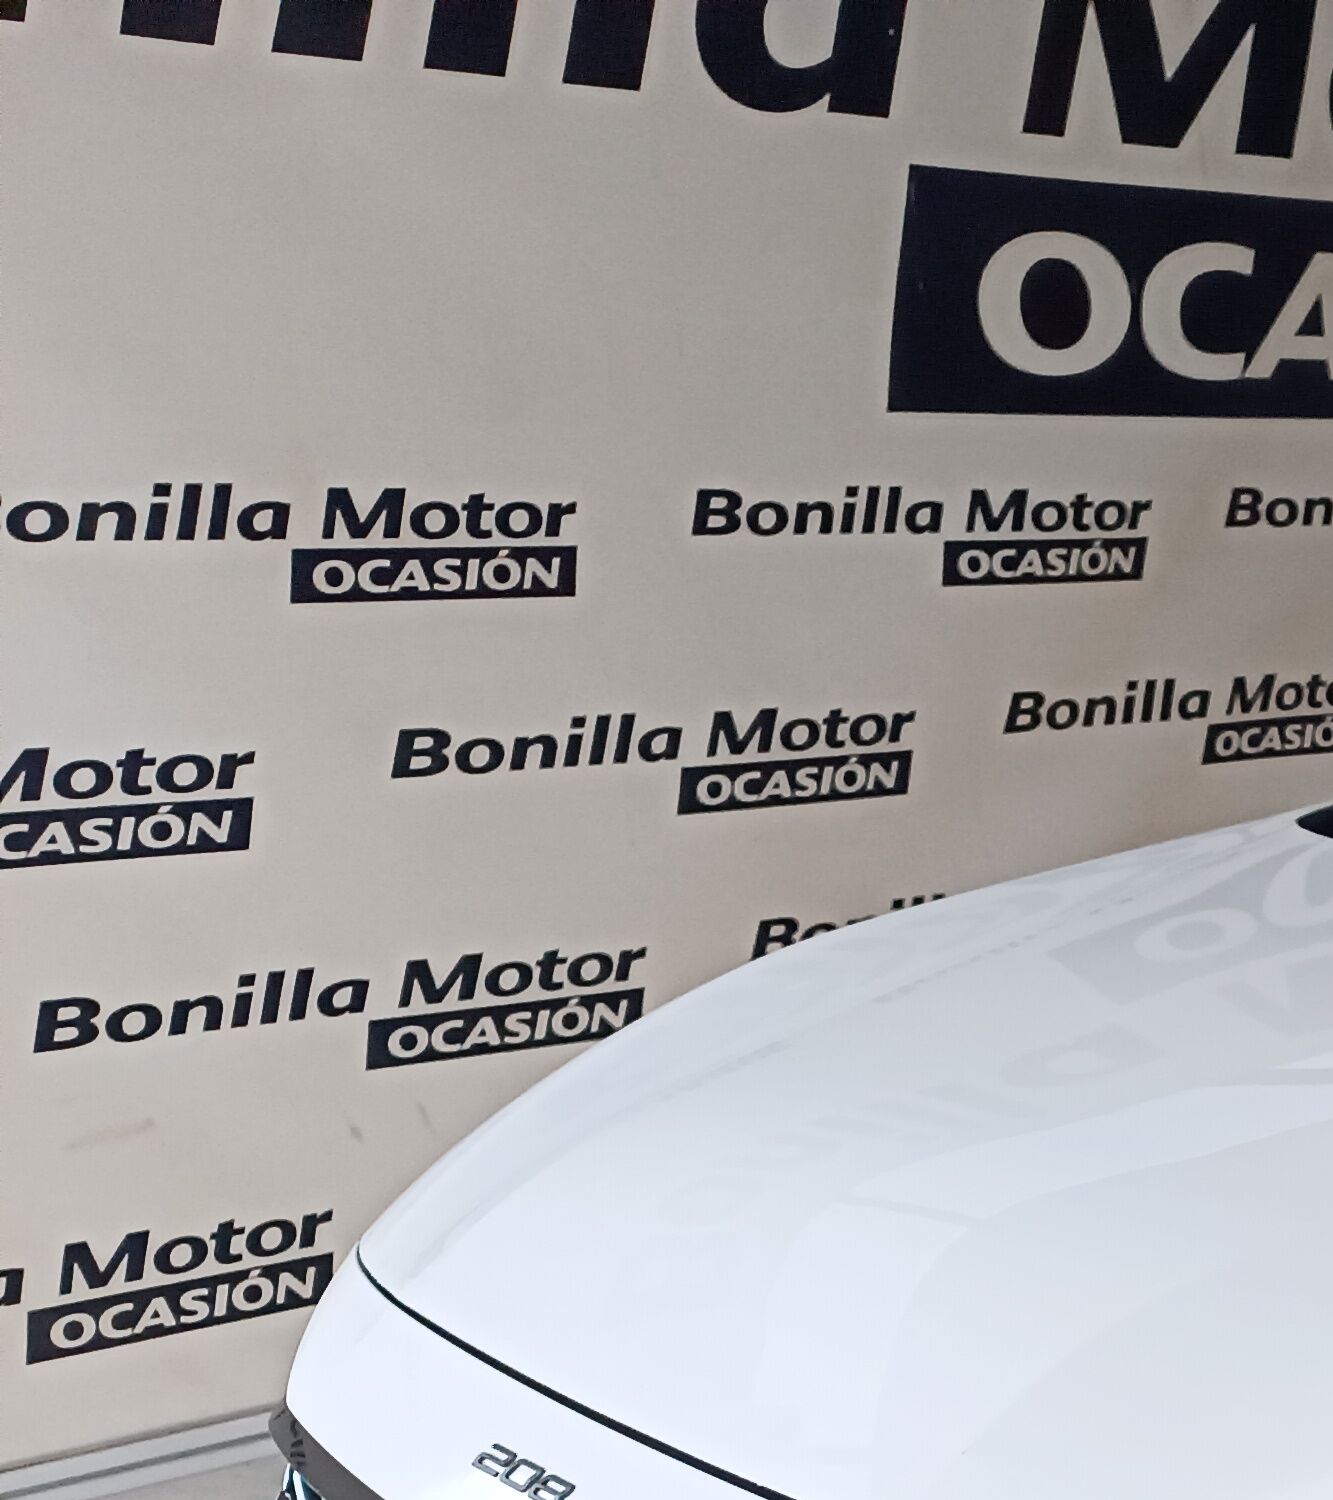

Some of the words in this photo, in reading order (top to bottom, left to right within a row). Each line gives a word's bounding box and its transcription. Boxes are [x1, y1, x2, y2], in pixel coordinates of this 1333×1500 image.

[0, 483, 290, 542] onilla
[321, 488, 577, 541] Motor
[691, 486, 943, 536] Bonilla
[966, 488, 1152, 534] Motor
[312, 549, 562, 594] OCASIÓN
[957, 542, 1136, 580] OCASIÓN
[1003, 678, 1211, 734] Bonilla
[391, 714, 682, 779] Bonilla
[705, 708, 916, 758] Motor
[695, 756, 900, 806] OCASIÓN
[33, 966, 369, 1053] Bonilla
[398, 946, 646, 1009] Motor
[387, 998, 629, 1059] OCASIÓN
[59, 1209, 333, 1296] Motor
[50, 1266, 316, 1349] OCASIÓN
